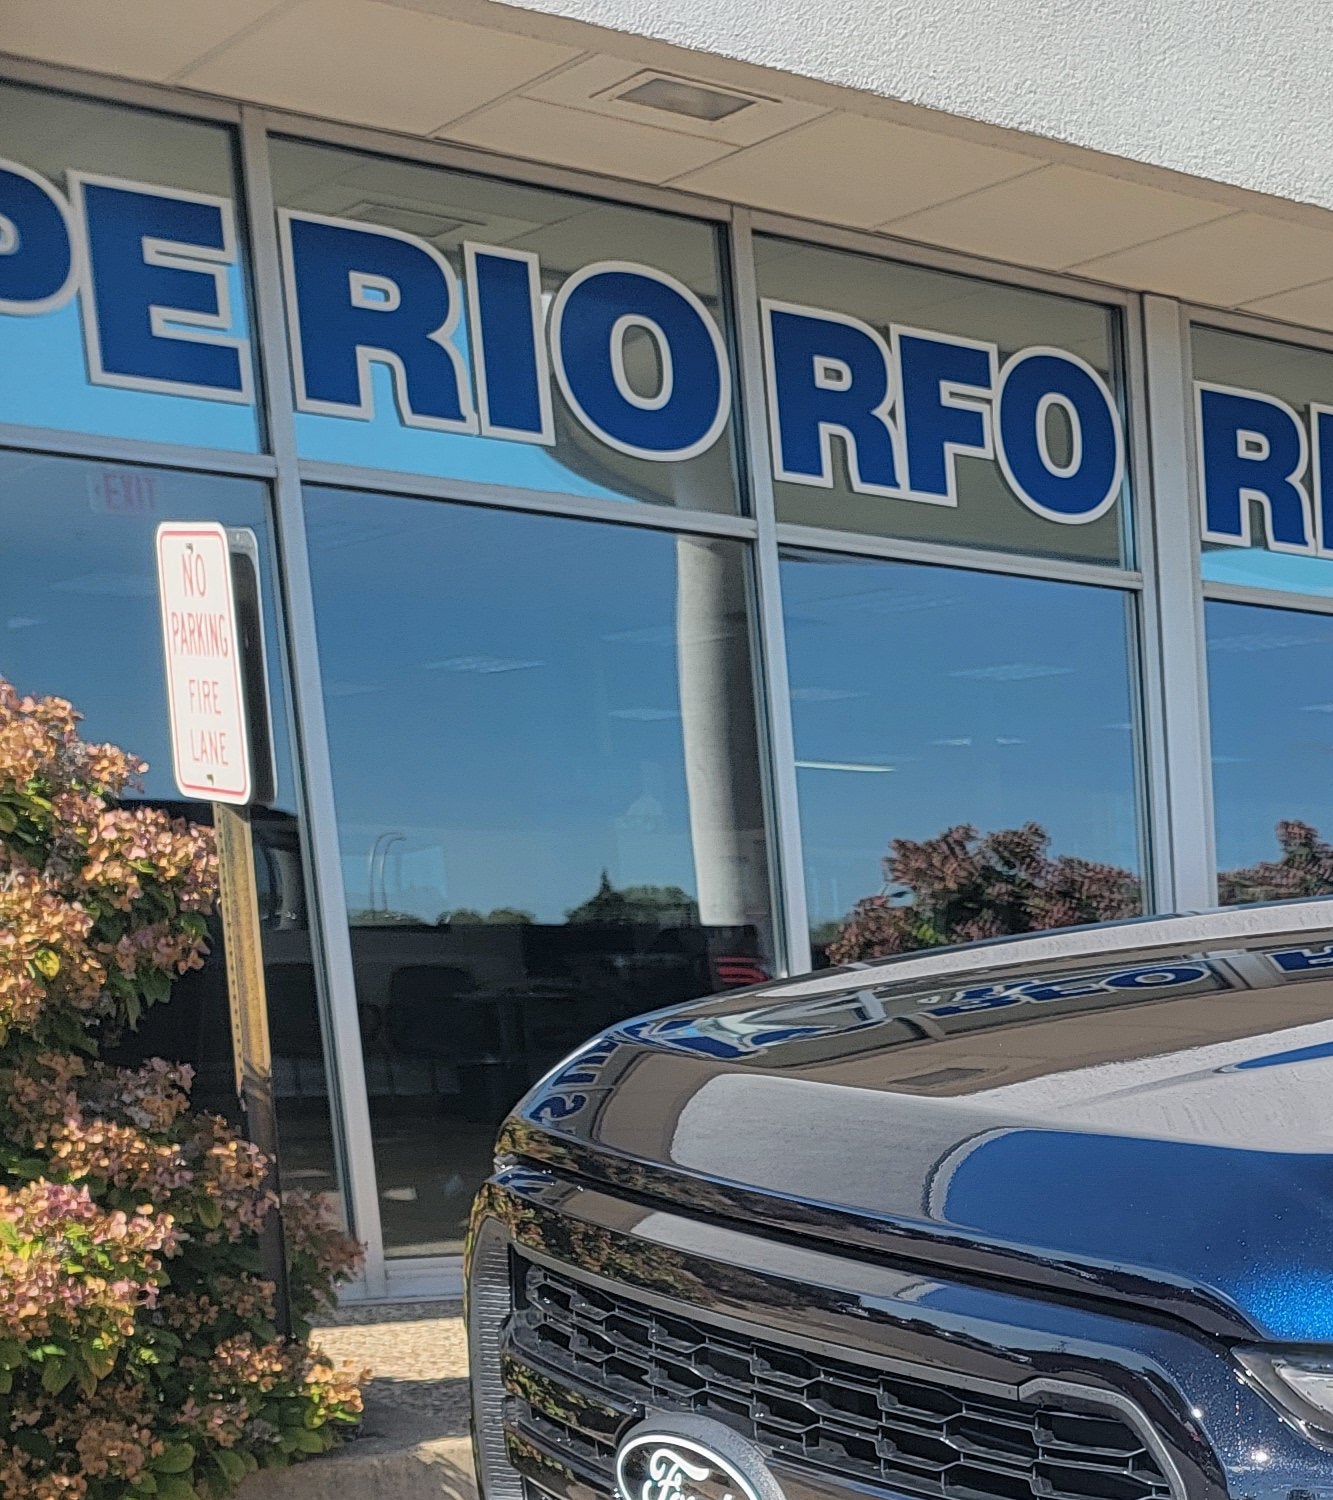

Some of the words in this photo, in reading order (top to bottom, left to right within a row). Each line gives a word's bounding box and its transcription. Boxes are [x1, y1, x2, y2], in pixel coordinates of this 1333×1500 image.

[182, 553, 206, 598] NO
[171, 612, 228, 657] PARKING
[189, 679, 221, 714] FIRE
[191, 730, 229, 766] LANE
